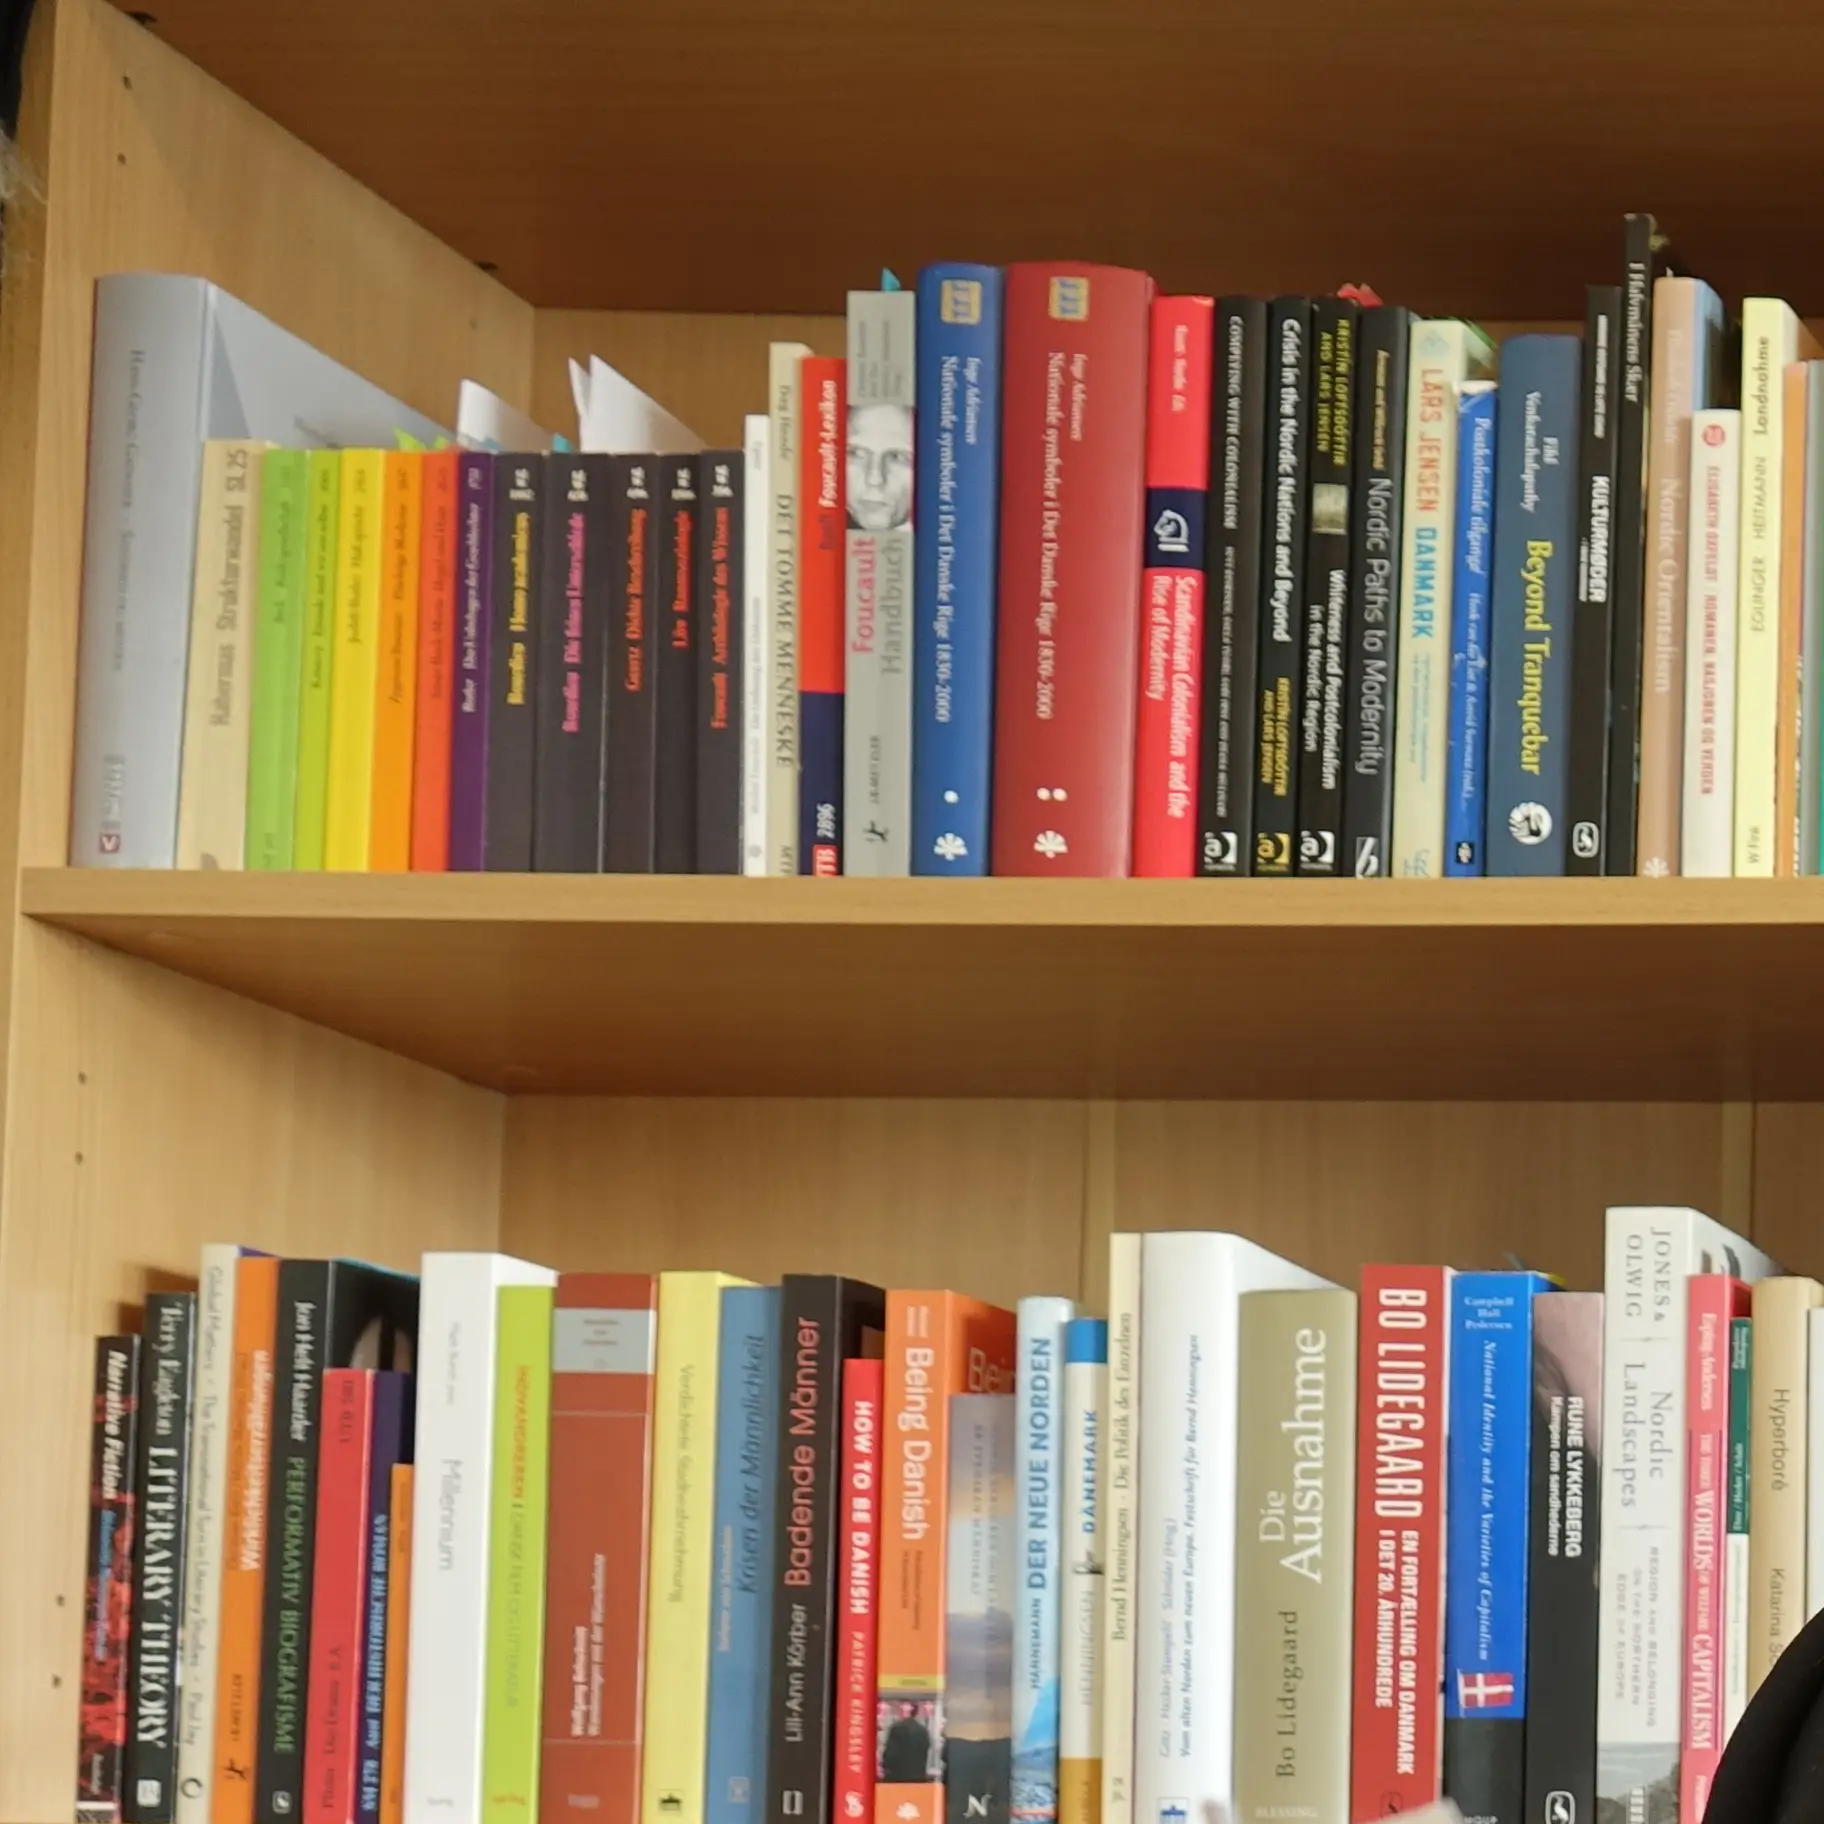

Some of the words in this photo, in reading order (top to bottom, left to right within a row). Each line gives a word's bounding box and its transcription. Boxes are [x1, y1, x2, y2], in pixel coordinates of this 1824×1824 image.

[1280, 320, 1298, 362] Crisis
[938, 356, 958, 426] Nationale
[1278, 386, 1296, 408] the
[1417, 369, 1441, 424] LARS
[819, 380, 837, 508] Foucault-Lexikon
[936, 431, 957, 500] symboler
[1277, 418, 1296, 471] Nordic
[1416, 432, 1440, 511] JENSEN
[776, 495, 794, 535] DET
[936, 515, 955, 541] Det
[1275, 477, 1295, 541] Nations
[1365, 479, 1391, 550] Nordic
[1588, 476, 1609, 602] KULTURMØDER
[775, 545, 794, 632] TOMME
[851, 538, 875, 653] Foucault
[935, 546, 955, 600] Danske
[1152, 576, 1172, 598] Rise
[1274, 546, 1293, 574] and
[1363, 559, 1389, 620] Paths
[1412, 528, 1437, 638] DANMARK
[1522, 541, 1551, 631] Beyond
[882, 538, 903, 674] Handbuch
[935, 606, 954, 638] Rige
[1172, 576, 1195, 663] Scandinavian
[1272, 581, 1292, 641] Beyond
[1307, 620, 1324, 643] the
[1325, 570, 1344, 641] Whiteness
[933, 643, 953, 721] 1830-2000
[1146, 624, 1170, 699] Modernity
[1305, 648, 1323, 693] Nordic
[1324, 645, 1342, 673] and
[775, 641, 794, 766] MENNESKE
[1170, 673, 1192, 755] Colonialism
[1303, 699, 1322, 751] Region
[1322, 677, 1342, 789] Postcolonialism
[1357, 659, 1386, 775] Modernity
[1519, 638, 1550, 774] Tranquebar
[1168, 795, 1188, 817] the
[1169, 761, 1189, 787] and
[1626, 1235, 1643, 1318] OLWIG
[1652, 1229, 1672, 1305] JONES
[787, 1318, 818, 1435] Männer
[899, 1347, 932, 1432] Being
[1028, 1339, 1051, 1450] NORDEN
[853, 1401, 873, 1453] HOW
[1282, 1329, 1326, 1583] Ausnahme
[1374, 1343, 1426, 1516] LIDEGAARD
[1546, 1397, 1563, 1445] Kampen
[1566, 1397, 1584, 1447] RUNE
[1614, 1363, 1645, 1507] Landscapes
[1649, 1391, 1674, 1478] Nordic
[1768, 1389, 1790, 1491] Hyperboré
[142, 1446, 178, 1603] LITERARY
[785, 1446, 815, 1586] Badende
[902, 1440, 932, 1540] Danish
[1028, 1460, 1049, 1529] NEUE
[1259, 1492, 1284, 1542] Die
[1547, 1472, 1563, 1555] sandhederne
[1564, 1452, 1583, 1557] LYKKEBERG
[850, 1531, 870, 1613] DANISH
[1027, 1539, 1049, 1589] DER
[1378, 1539, 1396, 1564] DET
[1378, 1567, 1396, 1594] 20.
[787, 1604, 807, 1668] Körber
[1399, 1556, 1418, 1656] FORTÆLLING
[136, 1615, 172, 1747] THEORY
[1276, 1611, 1303, 1736] Lidegaard
[1376, 1599, 1396, 1707] ÅRHUNDREDE
[785, 1674, 805, 1741] Lill-Ann
[1397, 1691, 1416, 1773] DANMARK
